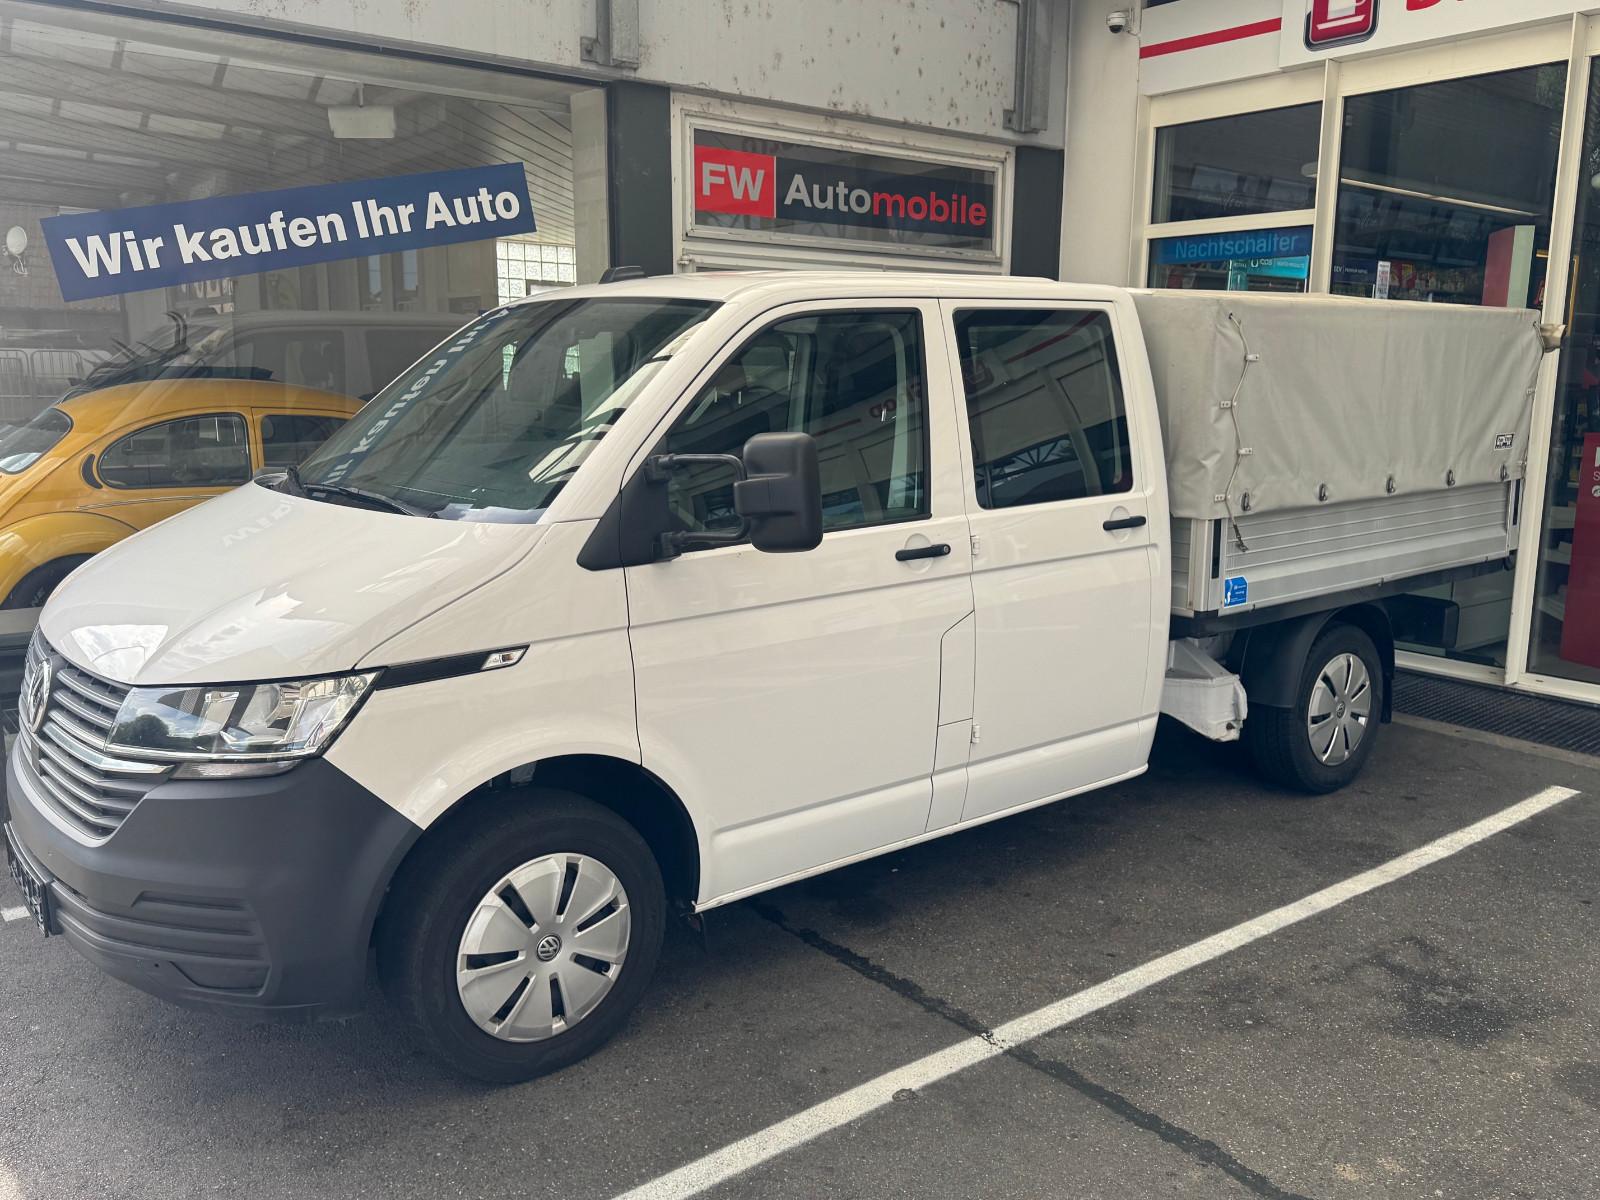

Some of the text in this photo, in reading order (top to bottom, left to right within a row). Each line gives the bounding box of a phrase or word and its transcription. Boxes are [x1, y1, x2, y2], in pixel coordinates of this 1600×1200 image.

[702, 161, 987, 226] FW Automobile
[65, 187, 520, 278] Wir kaufen Ihr Auto
[1175, 231, 1300, 259] Nachtschalter
[537, 935, 561, 961] VW
